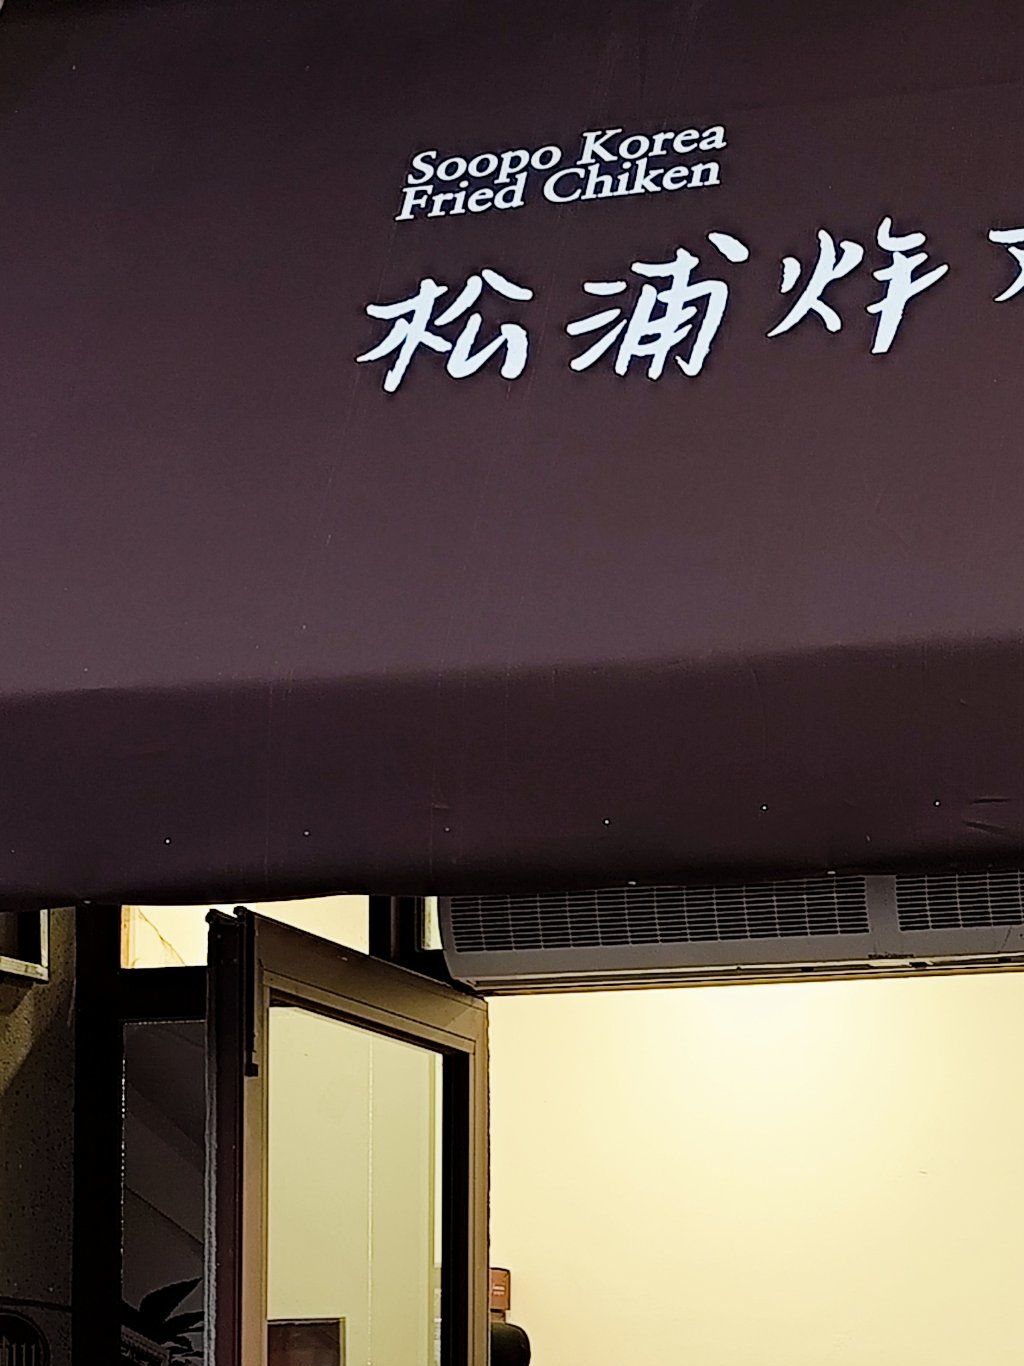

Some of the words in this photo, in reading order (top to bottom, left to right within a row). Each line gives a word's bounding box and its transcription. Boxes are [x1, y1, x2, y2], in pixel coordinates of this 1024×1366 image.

[407, 150, 562, 184] Soopo
[576, 126, 727, 165] Korea
[395, 172, 527, 220] Fried
[543, 159, 720, 203] Chiken
